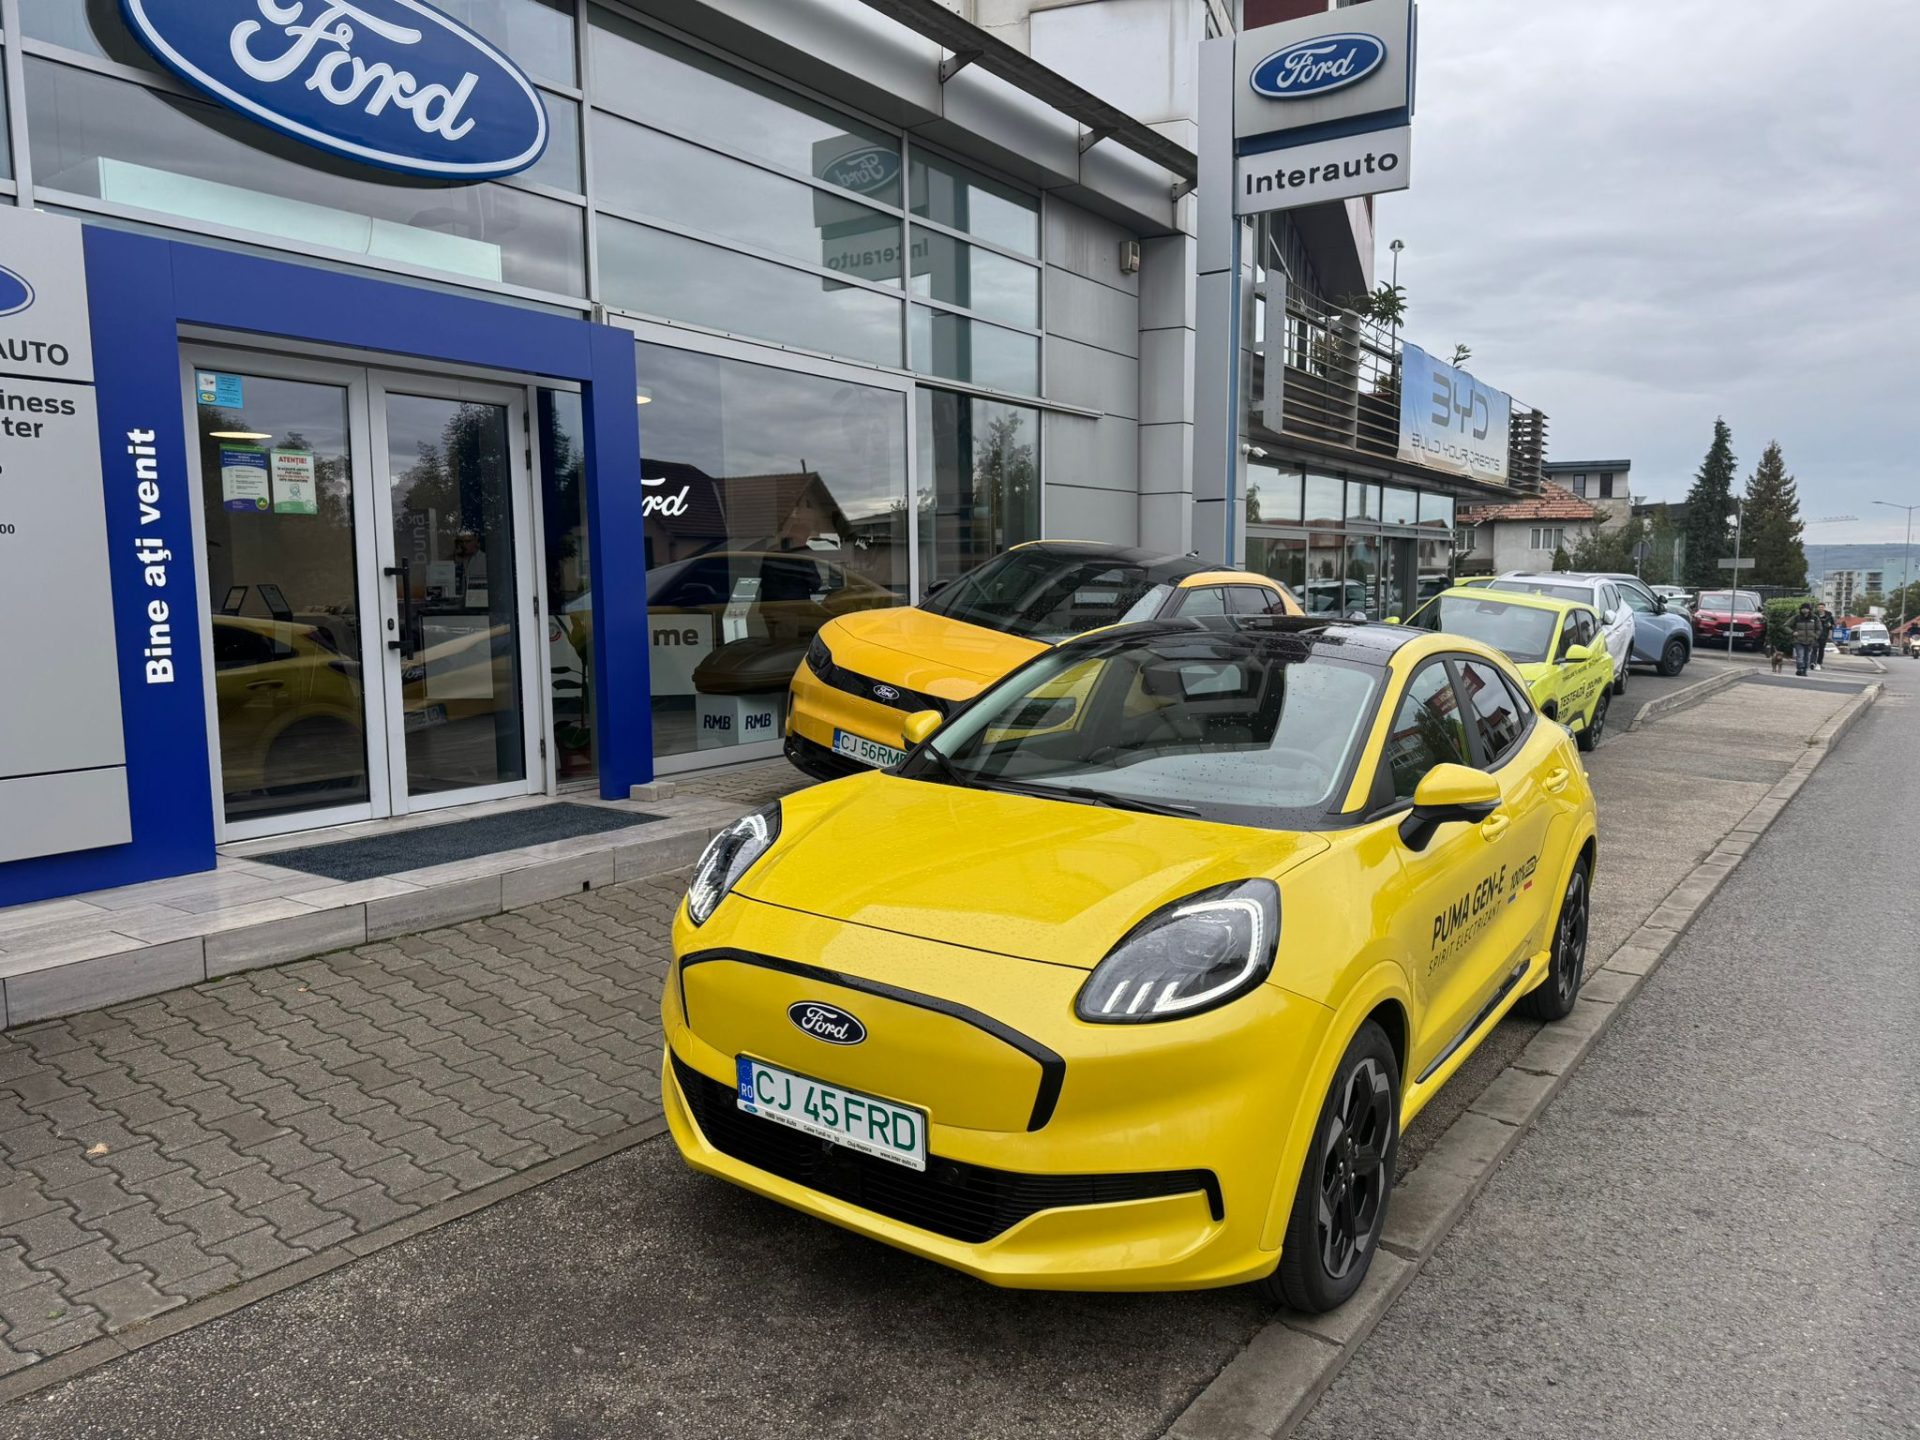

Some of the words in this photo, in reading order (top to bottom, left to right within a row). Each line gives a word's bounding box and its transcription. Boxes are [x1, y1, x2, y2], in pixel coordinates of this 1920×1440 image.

[230, 0, 479, 141] Ford
[1276, 44, 1357, 88] Ford
[1246, 152, 1398, 195] Interauto
[1431, 371, 1488, 440] BYD
[2, 416, 43, 438] ter
[1412, 432, 1441, 454] BUILD
[1443, 442, 1468, 461] YOUR
[127, 428, 161, 525] venit
[144, 600, 175, 684] Bine
[877, 685, 895, 698] Ford
[704, 714, 731, 730] RMB
[745, 713, 772, 730] RMB
[841, 735, 858, 753] CJ
[1431, 892, 1470, 951] PUMA
[1472, 864, 1506, 916] GEN-E
[1428, 940, 1455, 977] SPIRIT
[1455, 899, 1501, 952] ELECTRIZANT
[801, 1006, 849, 1039] Ford
[741, 1083, 753, 1098] RO
[756, 1070, 792, 1111] CJ
